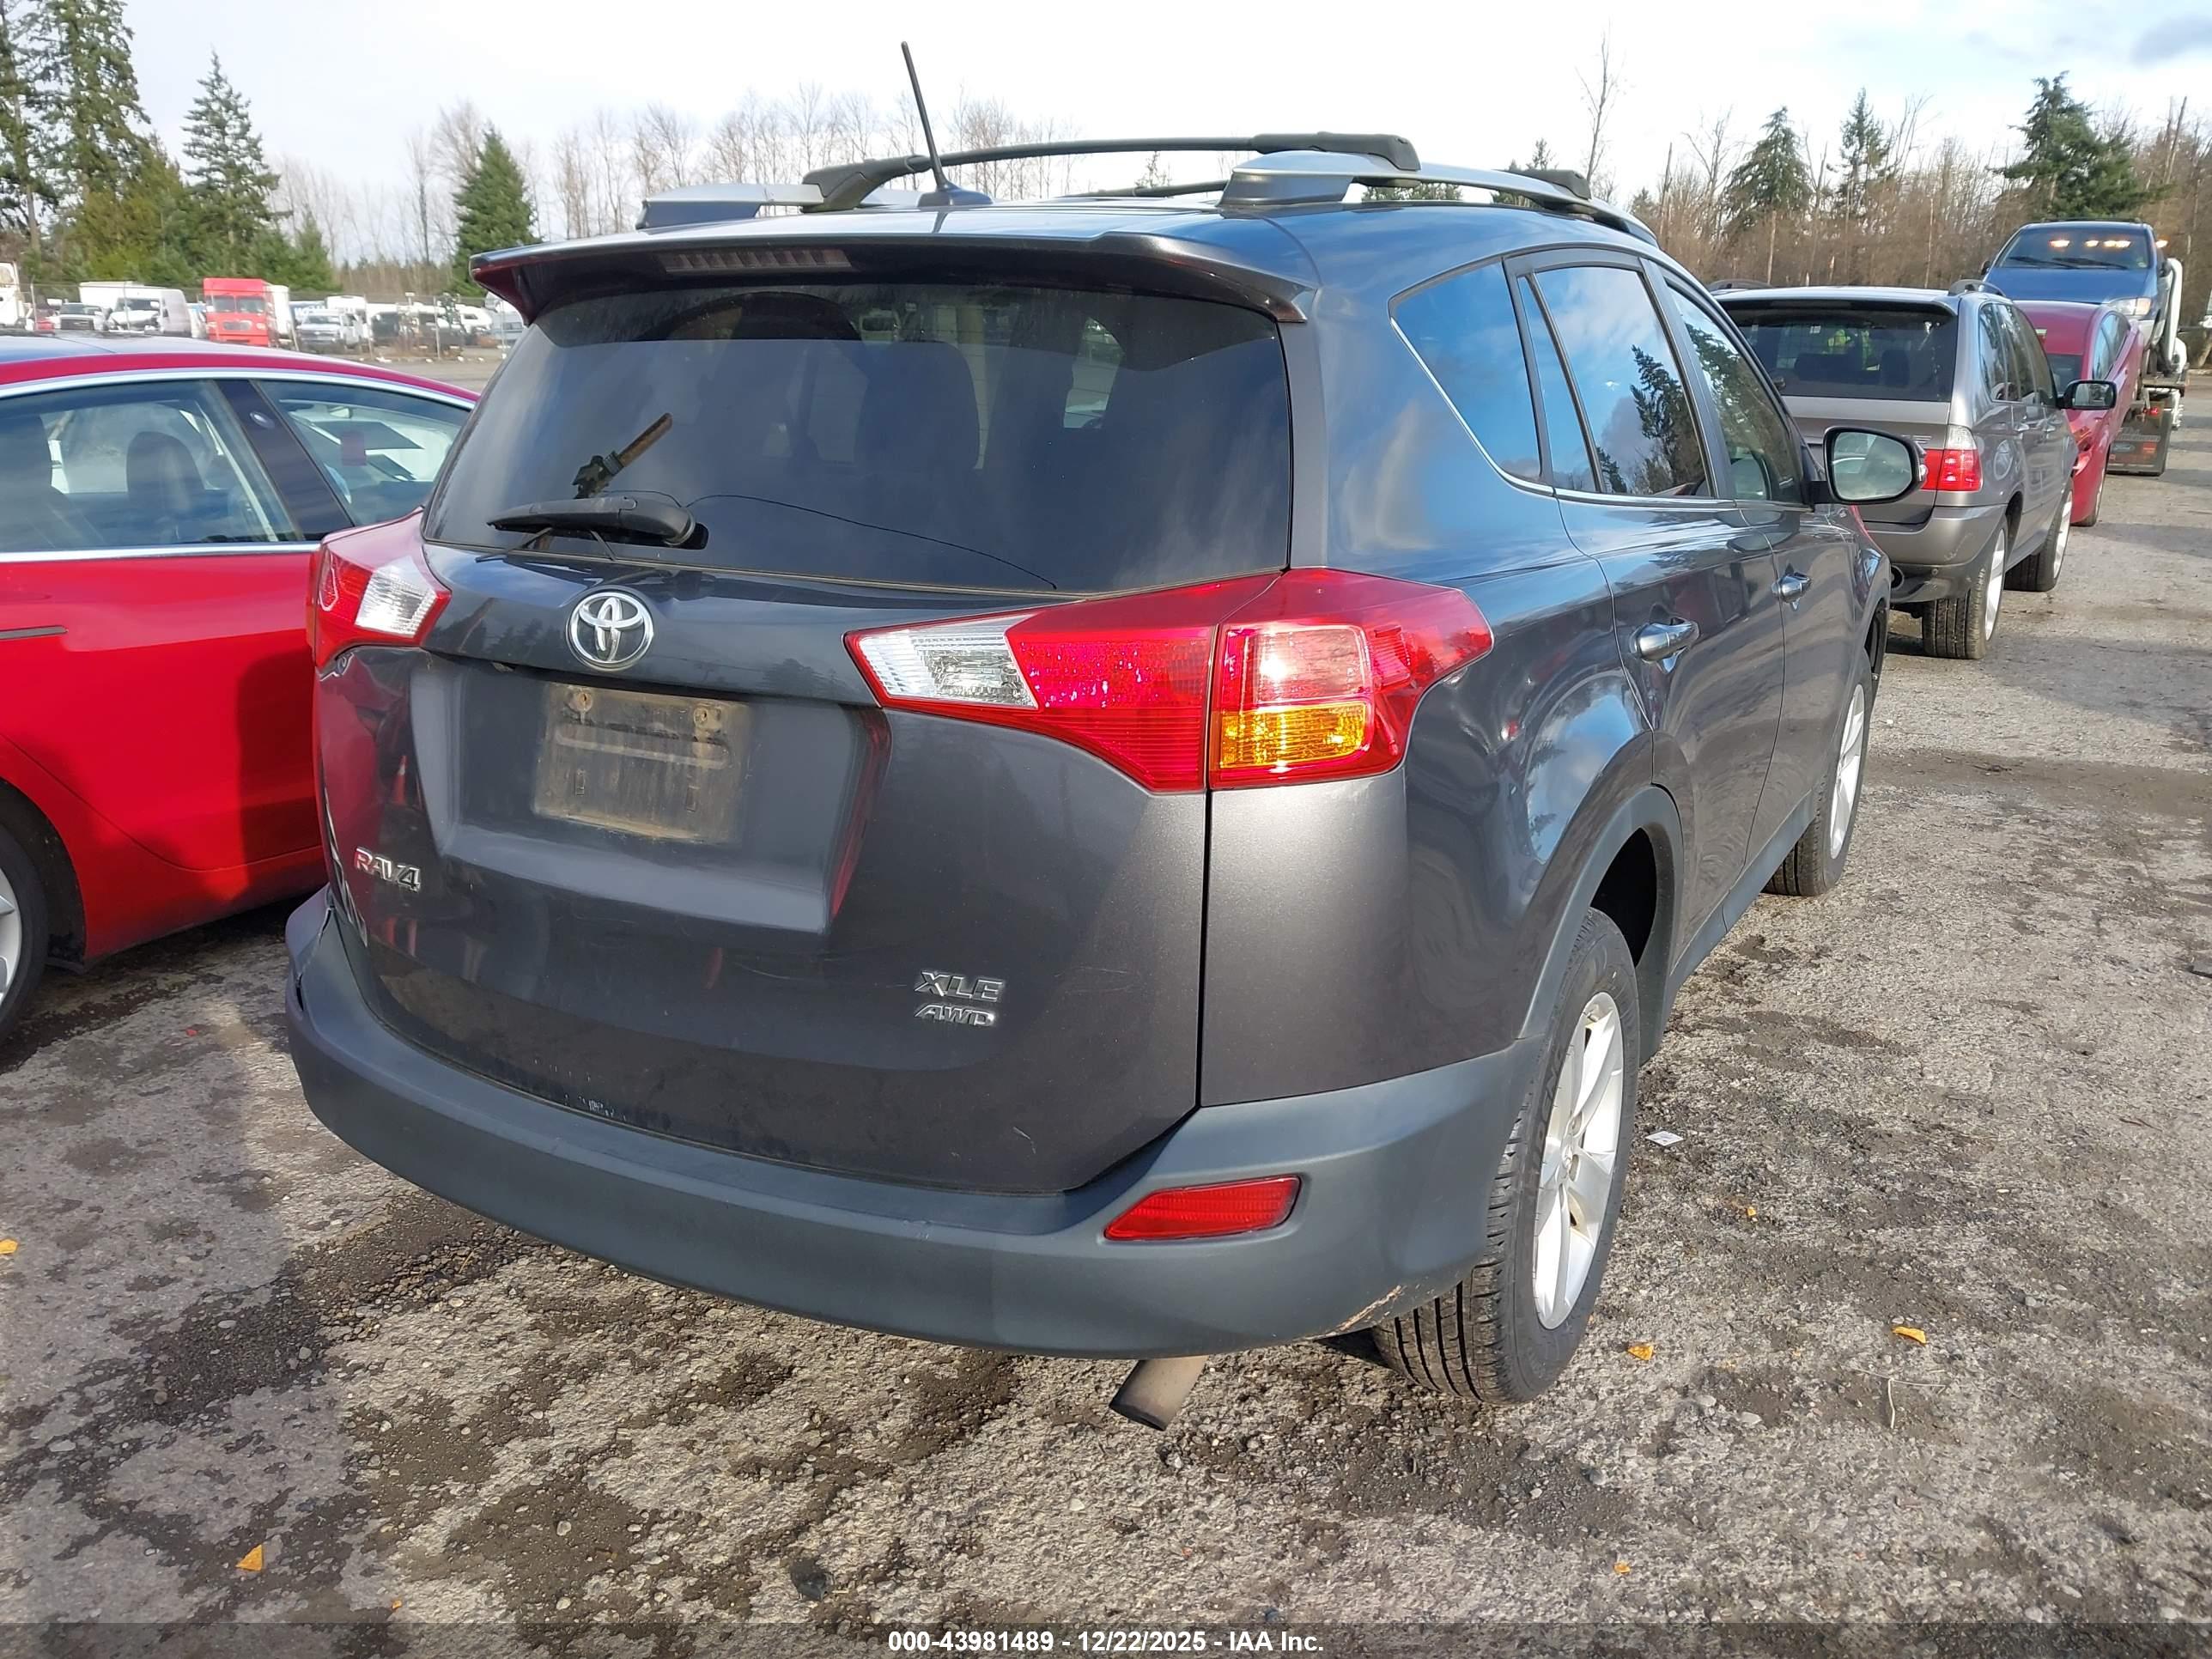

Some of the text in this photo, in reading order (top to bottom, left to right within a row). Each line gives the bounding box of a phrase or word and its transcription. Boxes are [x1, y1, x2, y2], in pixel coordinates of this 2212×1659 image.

[354, 846, 422, 892] RAV4
[914, 970, 1005, 1002] XLE
[914, 1003, 995, 1028] AWD
